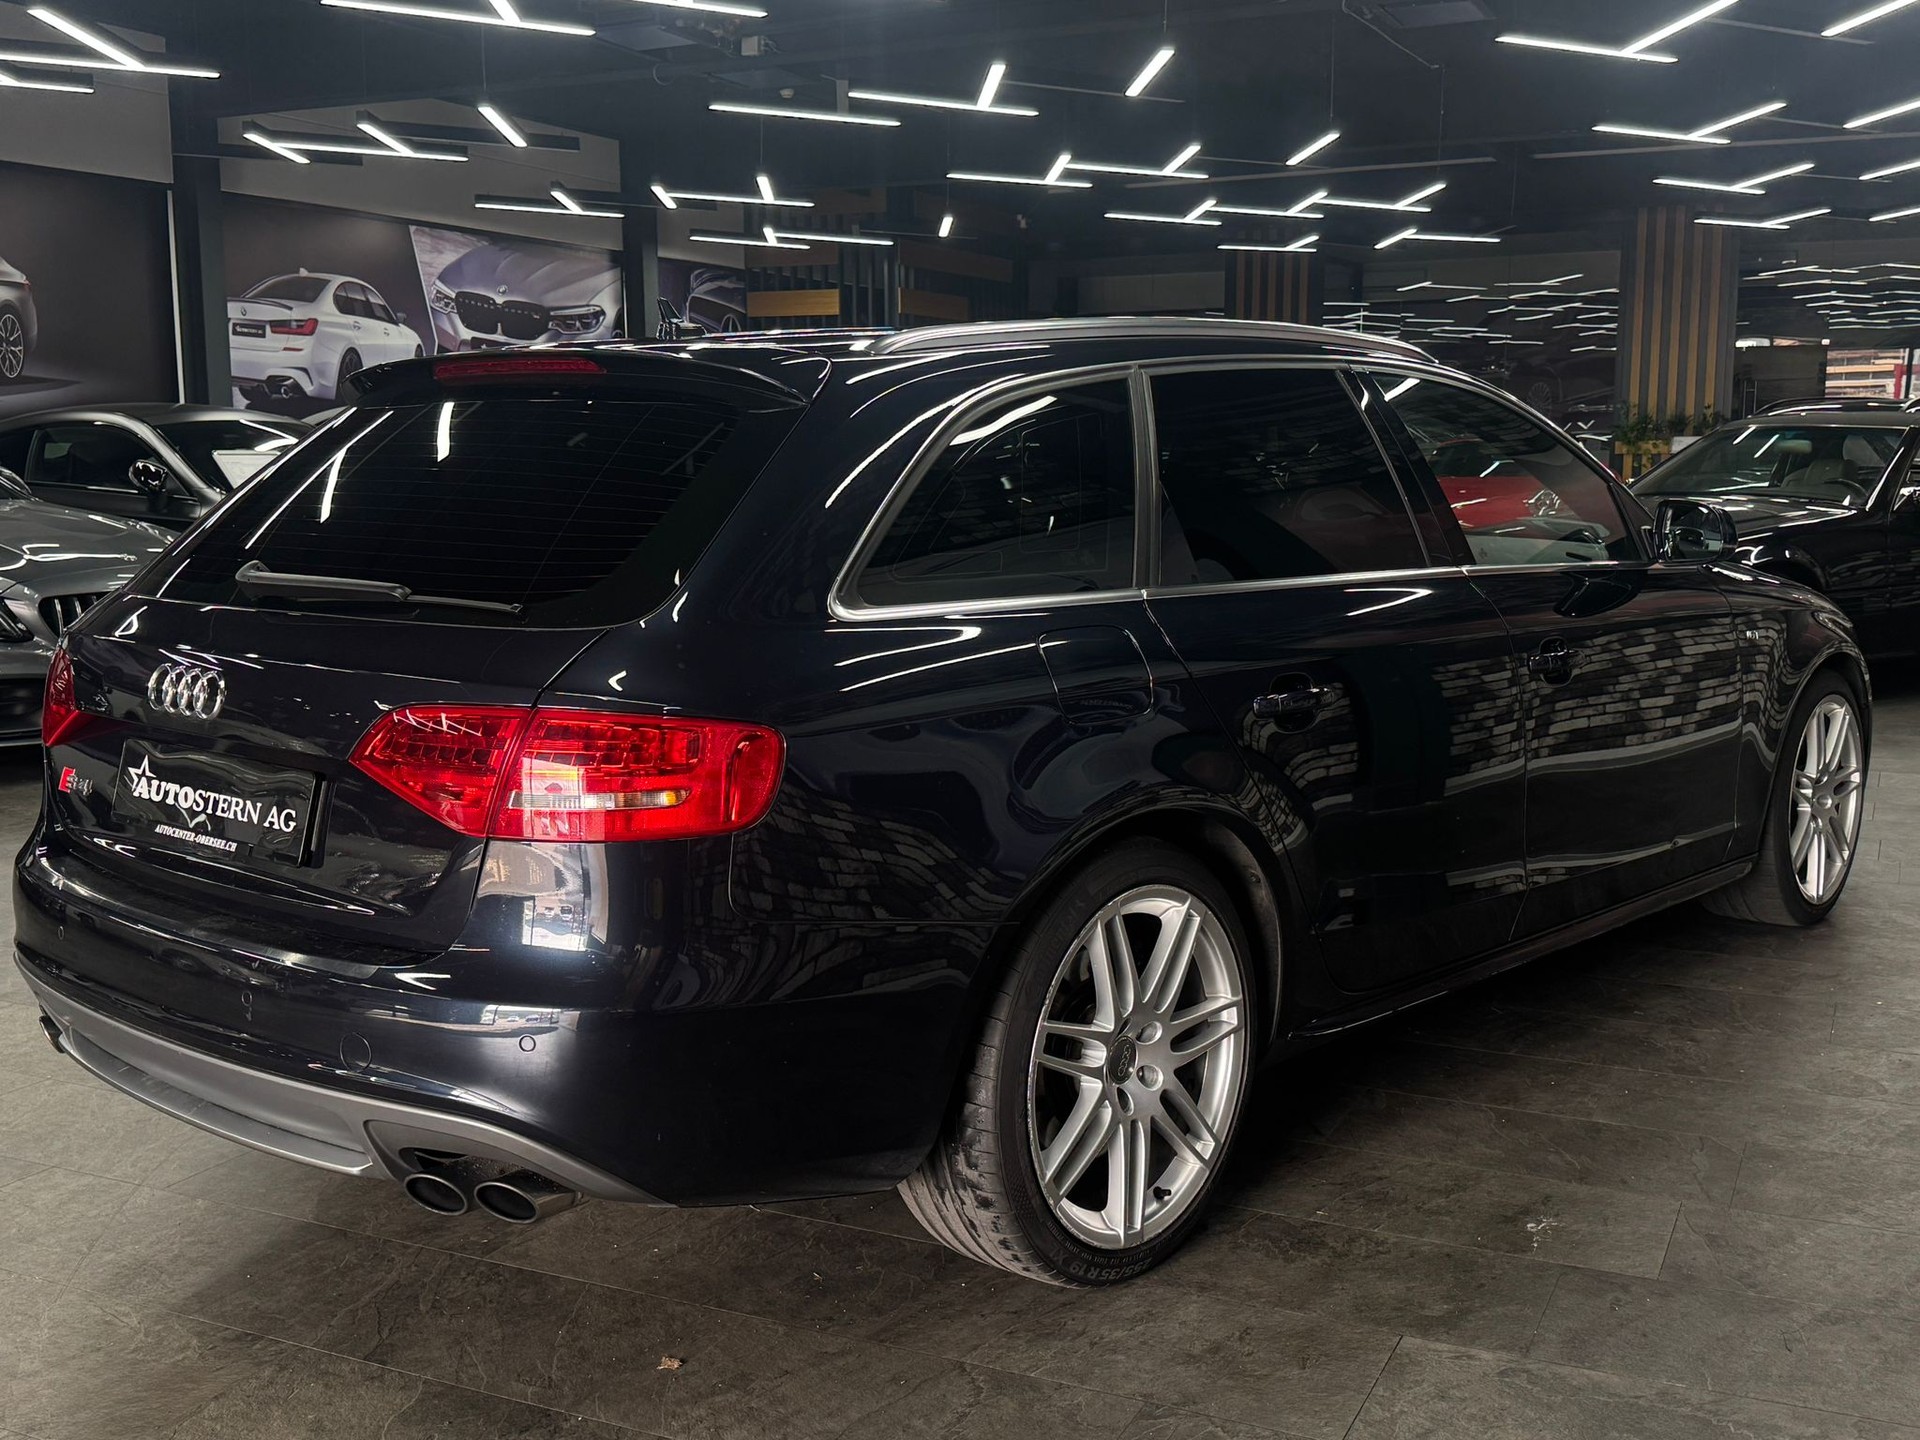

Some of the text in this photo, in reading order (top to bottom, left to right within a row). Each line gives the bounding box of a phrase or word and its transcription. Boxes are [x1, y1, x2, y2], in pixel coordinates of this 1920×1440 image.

[133, 776, 297, 832] AUTOSTERN AG
[154, 824, 238, 852] AUTOCENTER-OBERSEE.CH
